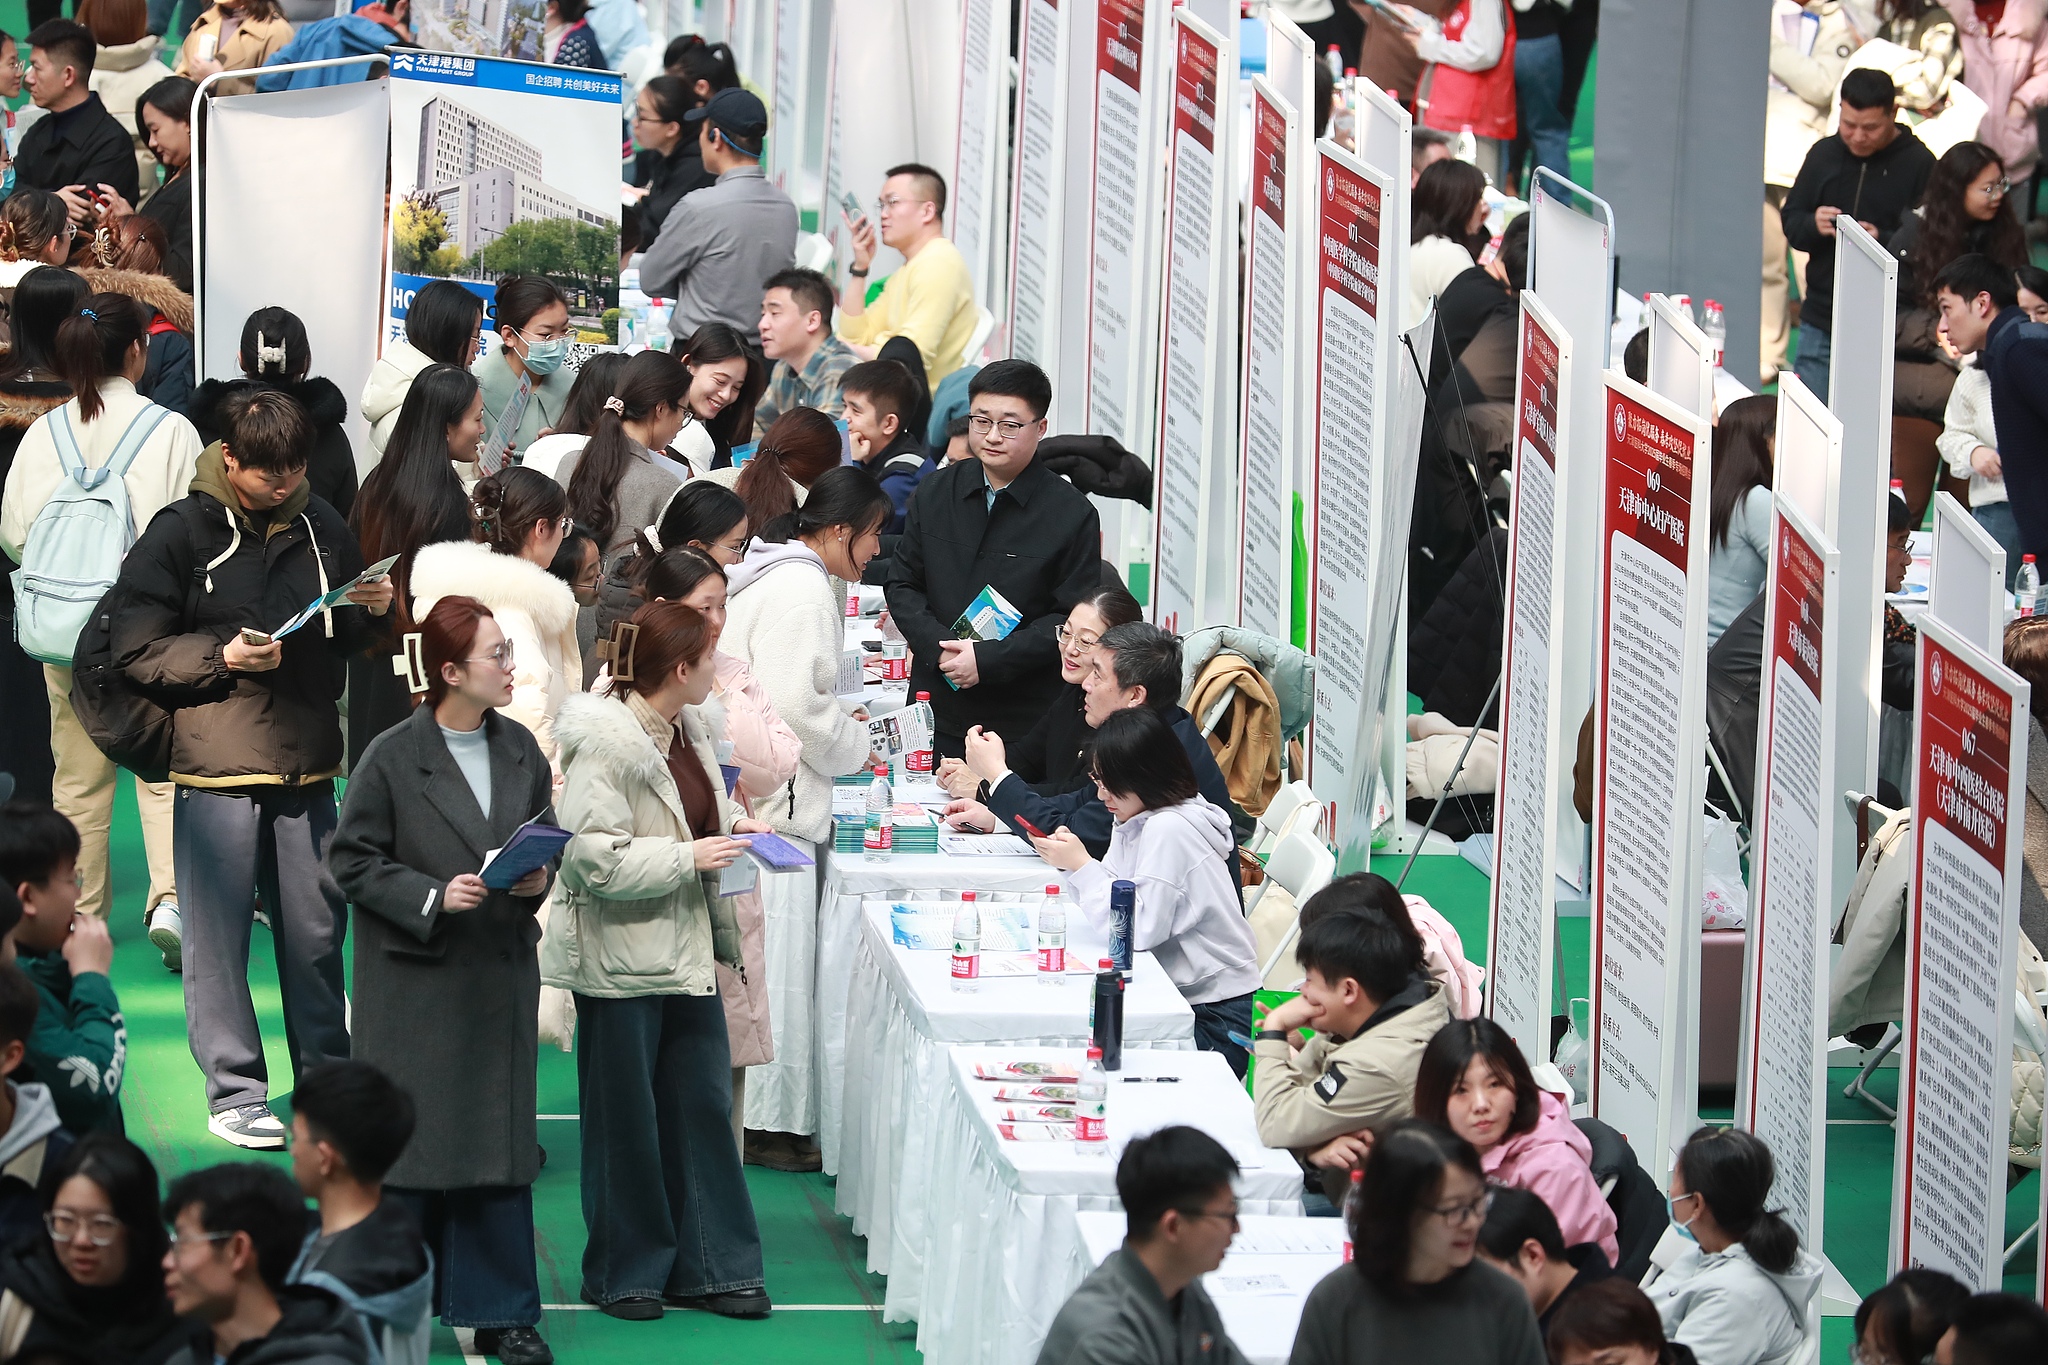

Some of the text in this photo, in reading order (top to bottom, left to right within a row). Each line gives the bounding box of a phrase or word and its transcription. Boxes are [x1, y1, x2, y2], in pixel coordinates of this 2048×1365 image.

[415, 53, 475, 71] 天津港集团
[415, 66, 437, 74] TIANJIN
[453, 69, 475, 78] GROUP
[525, 73, 620, 95] 国企招聘 共创美好未来
[1348, 222, 1358, 243] 071
[1646, 468, 1660, 492] 069
[1618, 486, 1685, 547] 天津市中心妇产医院
[1962, 727, 1976, 756] 067
[1929, 743, 2004, 824] 天津市中西医结合医院
[1936, 785, 1996, 849] (天津市南开医院)
